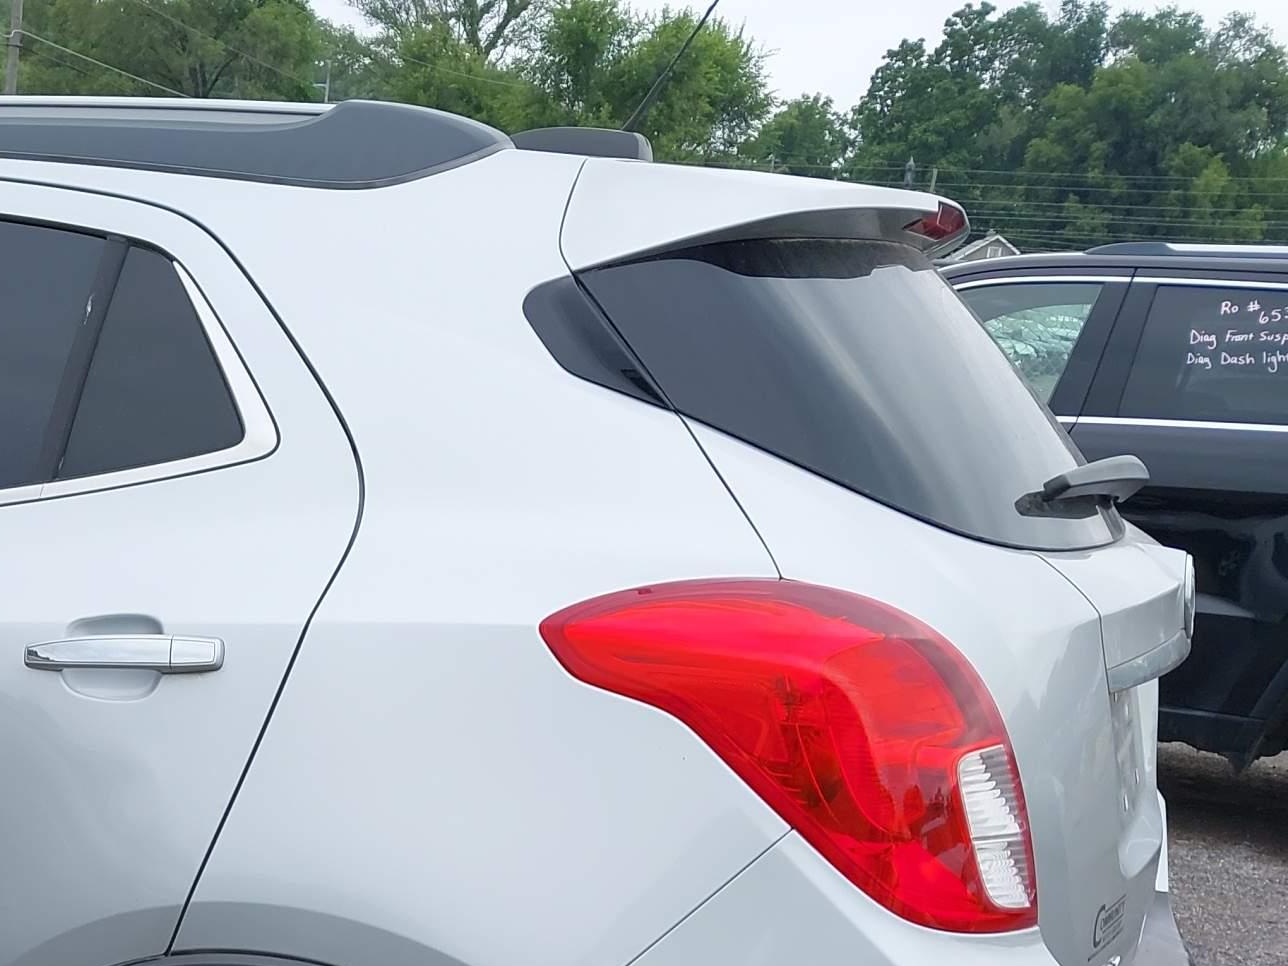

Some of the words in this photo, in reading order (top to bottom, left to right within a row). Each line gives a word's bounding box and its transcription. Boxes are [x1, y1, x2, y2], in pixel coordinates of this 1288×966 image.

[1220, 301, 1239, 316] Ro
[1189, 329, 1217, 350] Diag
[1225, 329, 1254, 343] Front
[1186, 352, 1212, 369] Diag
[1220, 351, 1255, 365] Dash
